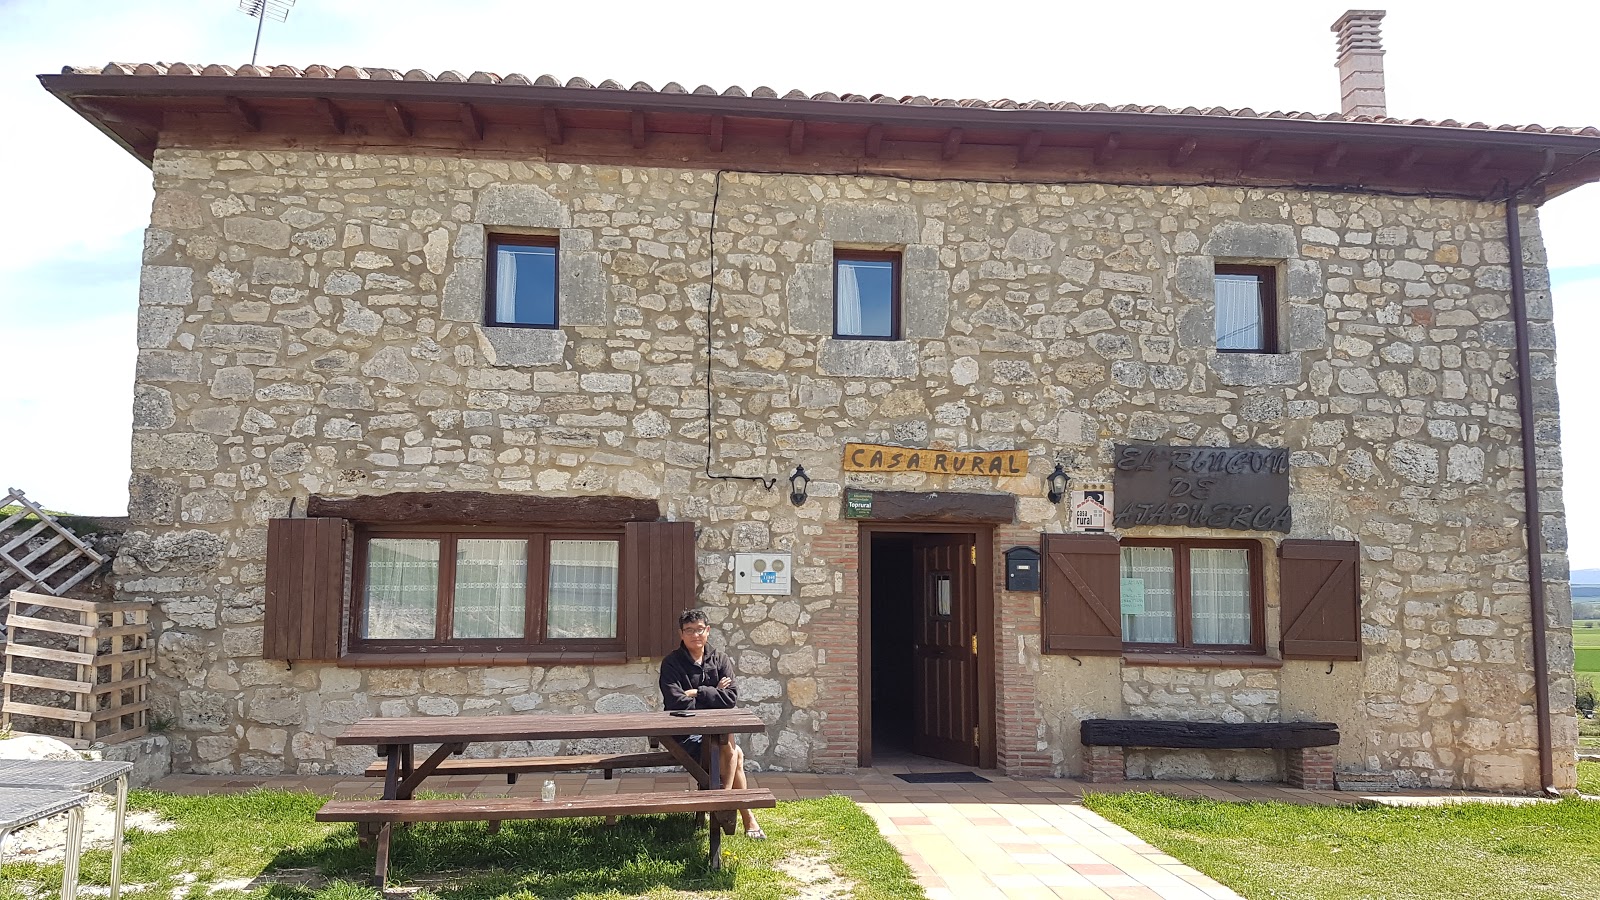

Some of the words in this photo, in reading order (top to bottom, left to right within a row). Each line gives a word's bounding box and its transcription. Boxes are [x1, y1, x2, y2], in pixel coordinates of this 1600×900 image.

[851, 448, 920, 469] CASA
[933, 453, 1021, 474] RURAL
[1116, 447, 1156, 472] EL
[1168, 476, 1216, 500] DE
[849, 501, 872, 509] Toprural
[1113, 501, 1293, 529] ATAPUERCA
[1076, 514, 1093, 526] rural
